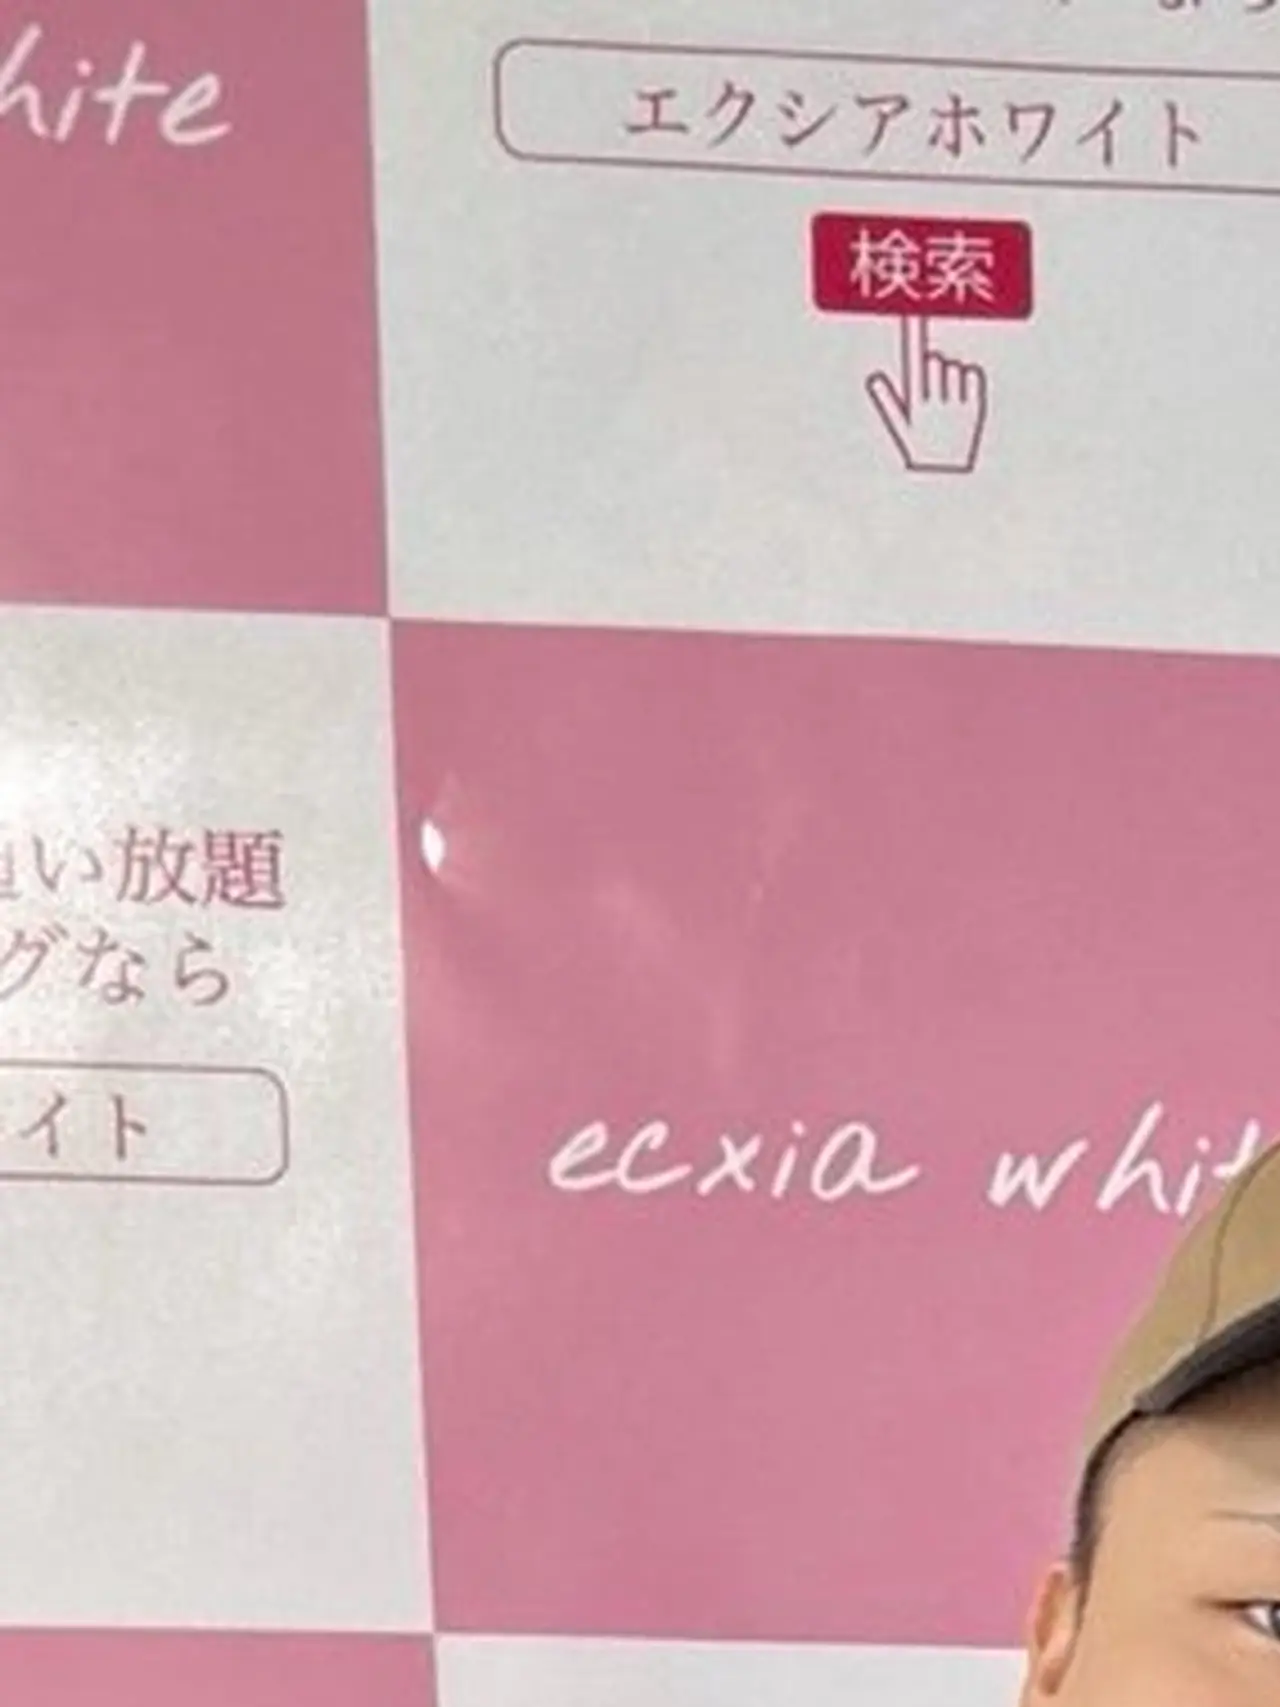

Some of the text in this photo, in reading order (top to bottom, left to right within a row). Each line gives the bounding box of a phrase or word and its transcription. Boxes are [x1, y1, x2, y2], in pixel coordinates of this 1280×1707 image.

[623, 82, 1203, 170] エクシアホワイト
[851, 227, 996, 304] 検索
[547, 1120, 920, 1201] ecxia
